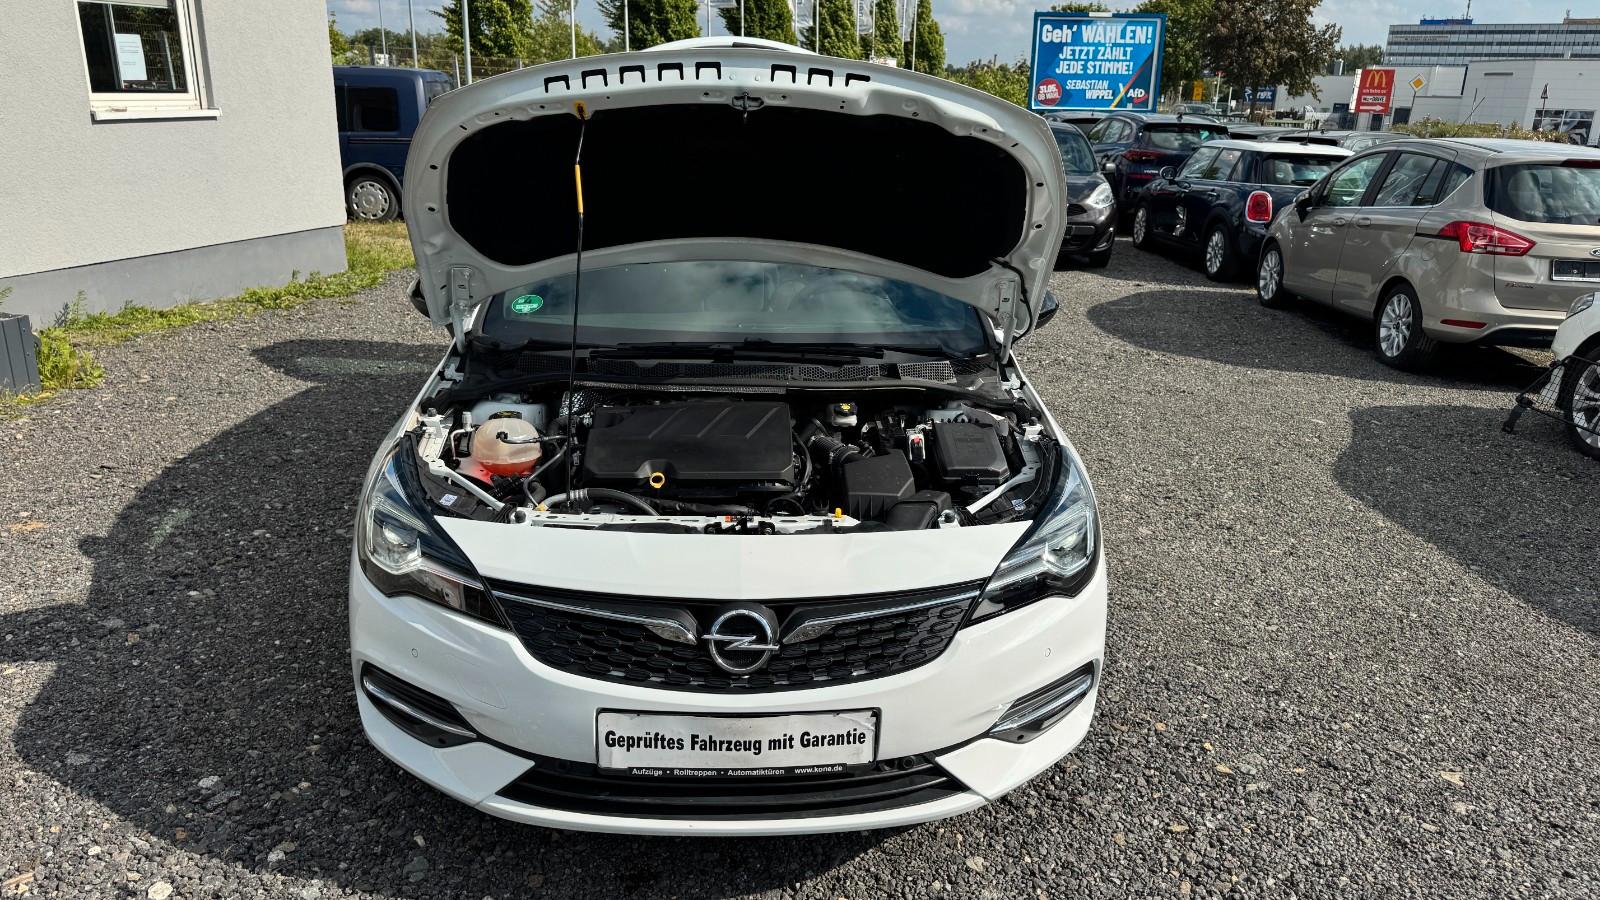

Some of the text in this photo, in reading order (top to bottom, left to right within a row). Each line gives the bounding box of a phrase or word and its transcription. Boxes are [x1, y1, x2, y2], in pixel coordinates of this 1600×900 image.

[1081, 21, 1153, 44] WÄHLEN!
[1059, 44, 1133, 60] JETZT ZÄHLT
[1055, 61, 1133, 75] JEDE STIMME!
[1066, 80, 1109, 90] SEBASTIAN
[1085, 90, 1114, 100] WIPPEL
[1127, 88, 1146, 98] AfD
[604, 728, 866, 755] Geprüftes Fahrzeug mit Garantie
[632, 764, 843, 777] Aufzüge Rolltreppen Automatiktüren www.kone.de
